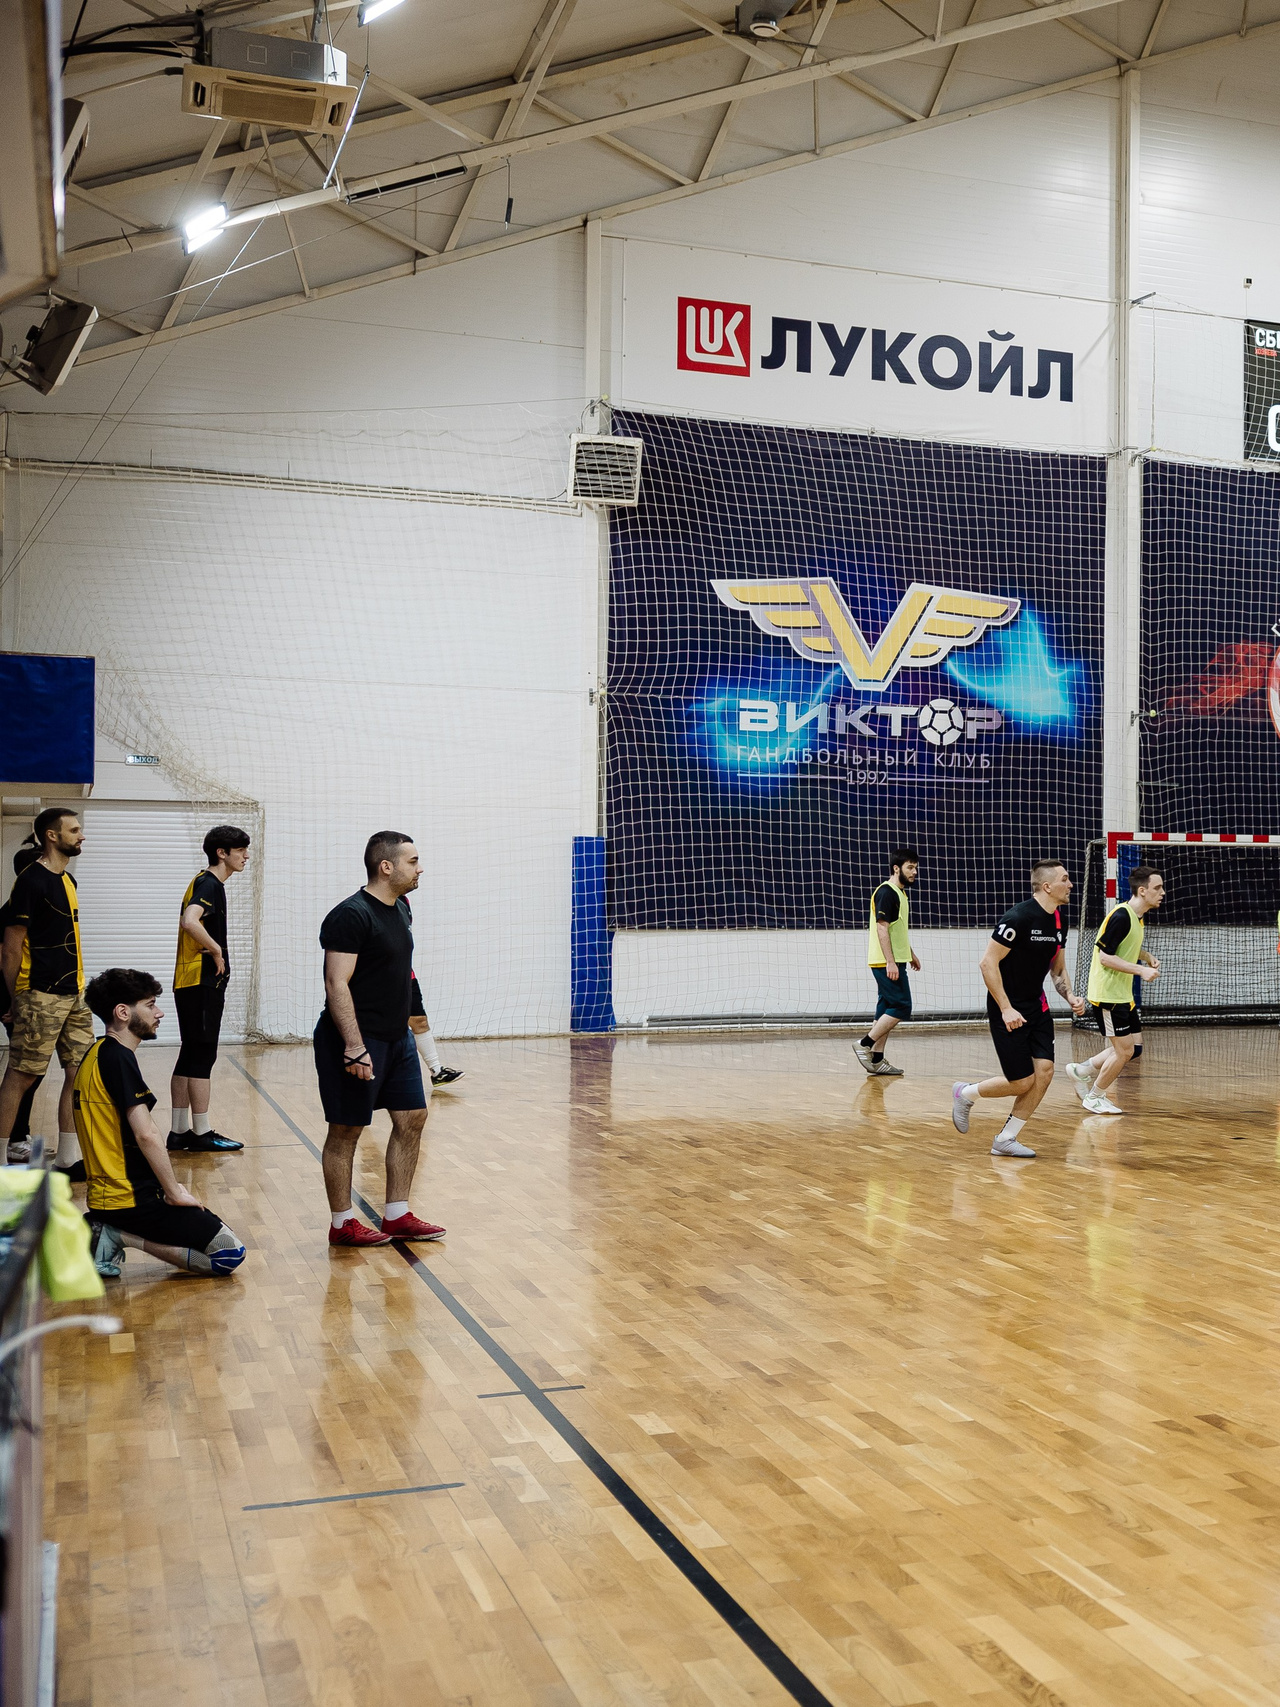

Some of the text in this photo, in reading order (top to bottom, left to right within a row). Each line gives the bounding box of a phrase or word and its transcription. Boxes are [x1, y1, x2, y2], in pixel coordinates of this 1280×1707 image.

[761, 315, 1074, 403] ЛУКОЙЛ
[738, 698, 1003, 746] ВИКТОР
[737, 745, 991, 769] ГАНДБОЛЬНЫЙ КЛУБ
[847, 770, 889, 786] 1992
[998, 924, 1016, 941] 10
